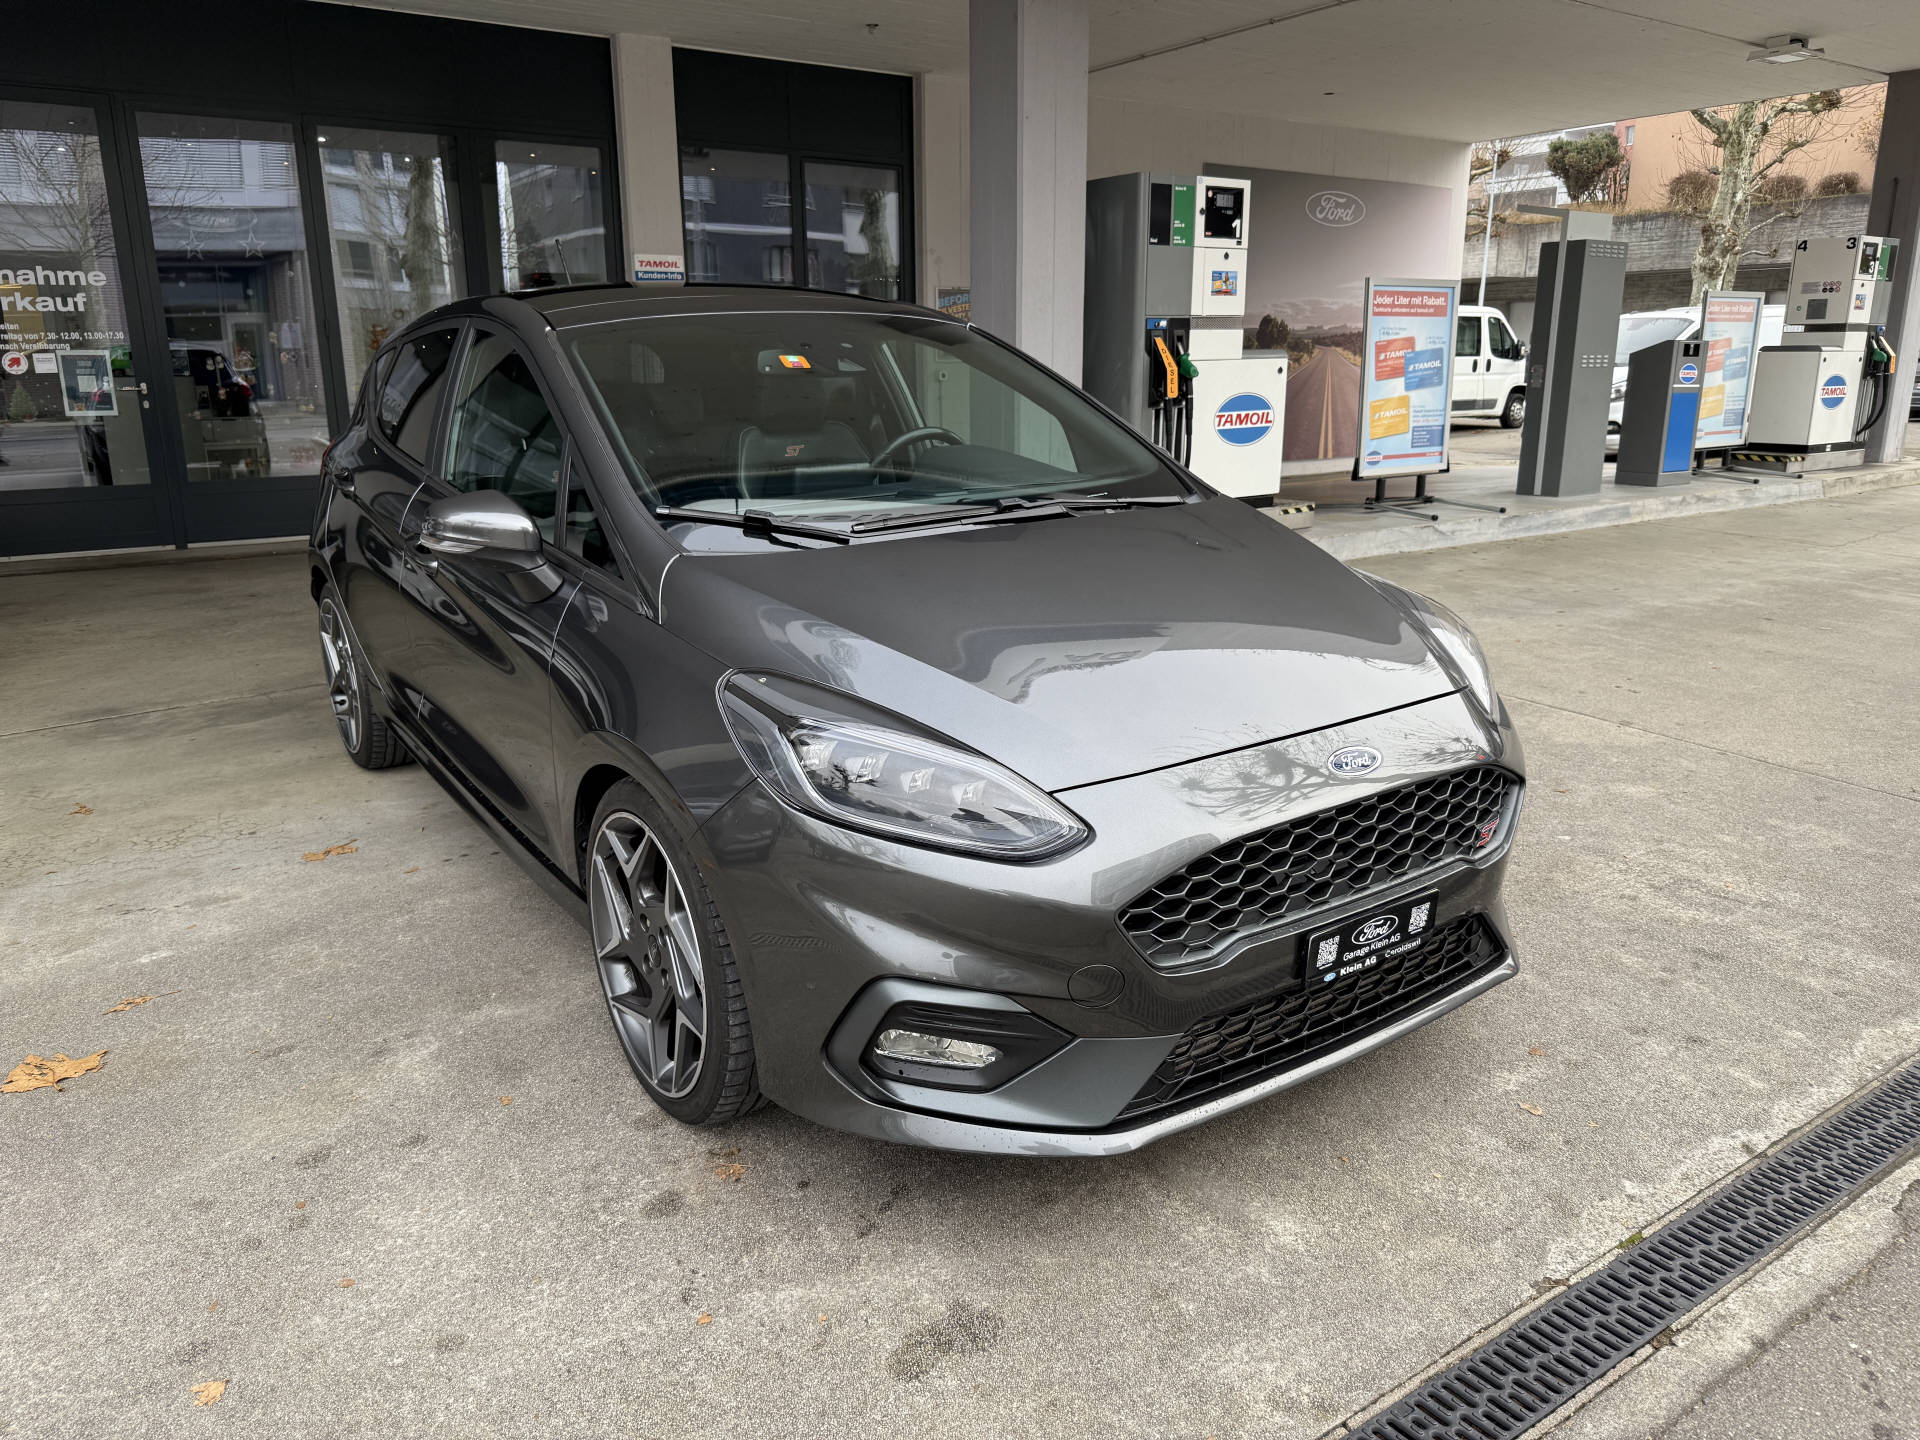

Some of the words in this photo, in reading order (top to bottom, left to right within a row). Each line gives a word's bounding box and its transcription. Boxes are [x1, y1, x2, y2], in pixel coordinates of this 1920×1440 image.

[1316, 194, 1355, 221] Ford
[1231, 218, 1241, 238] 1
[1797, 240, 1808, 252] 4
[1846, 237, 1857, 249] 3
[638, 260, 681, 268] TAMOIL
[0, 266, 107, 286] nahme
[638, 272, 682, 280] Kunden-Info
[0, 292, 87, 312] rkauf
[1373, 295, 1393, 305] Jeder
[1394, 296, 1410, 305] Liter
[1411, 296, 1421, 305] mit
[1423, 296, 1446, 305] Rabatt.
[20, 342, 70, 351] Vereinbarung
[1161, 348, 1176, 394] DIESEL
[1821, 387, 1847, 396] TAMOIL
[1216, 411, 1273, 427] TAMOIL
[1341, 752, 1371, 770] Ford
[1476, 815, 1499, 848] ST
[1360, 920, 1391, 942] Ford
[1343, 945, 1369, 961] Garage
[1370, 940, 1388, 951] Klein
[1389, 933, 1401, 944] AG
[1340, 963, 1362, 976] Klein
[1364, 956, 1377, 967] AG
